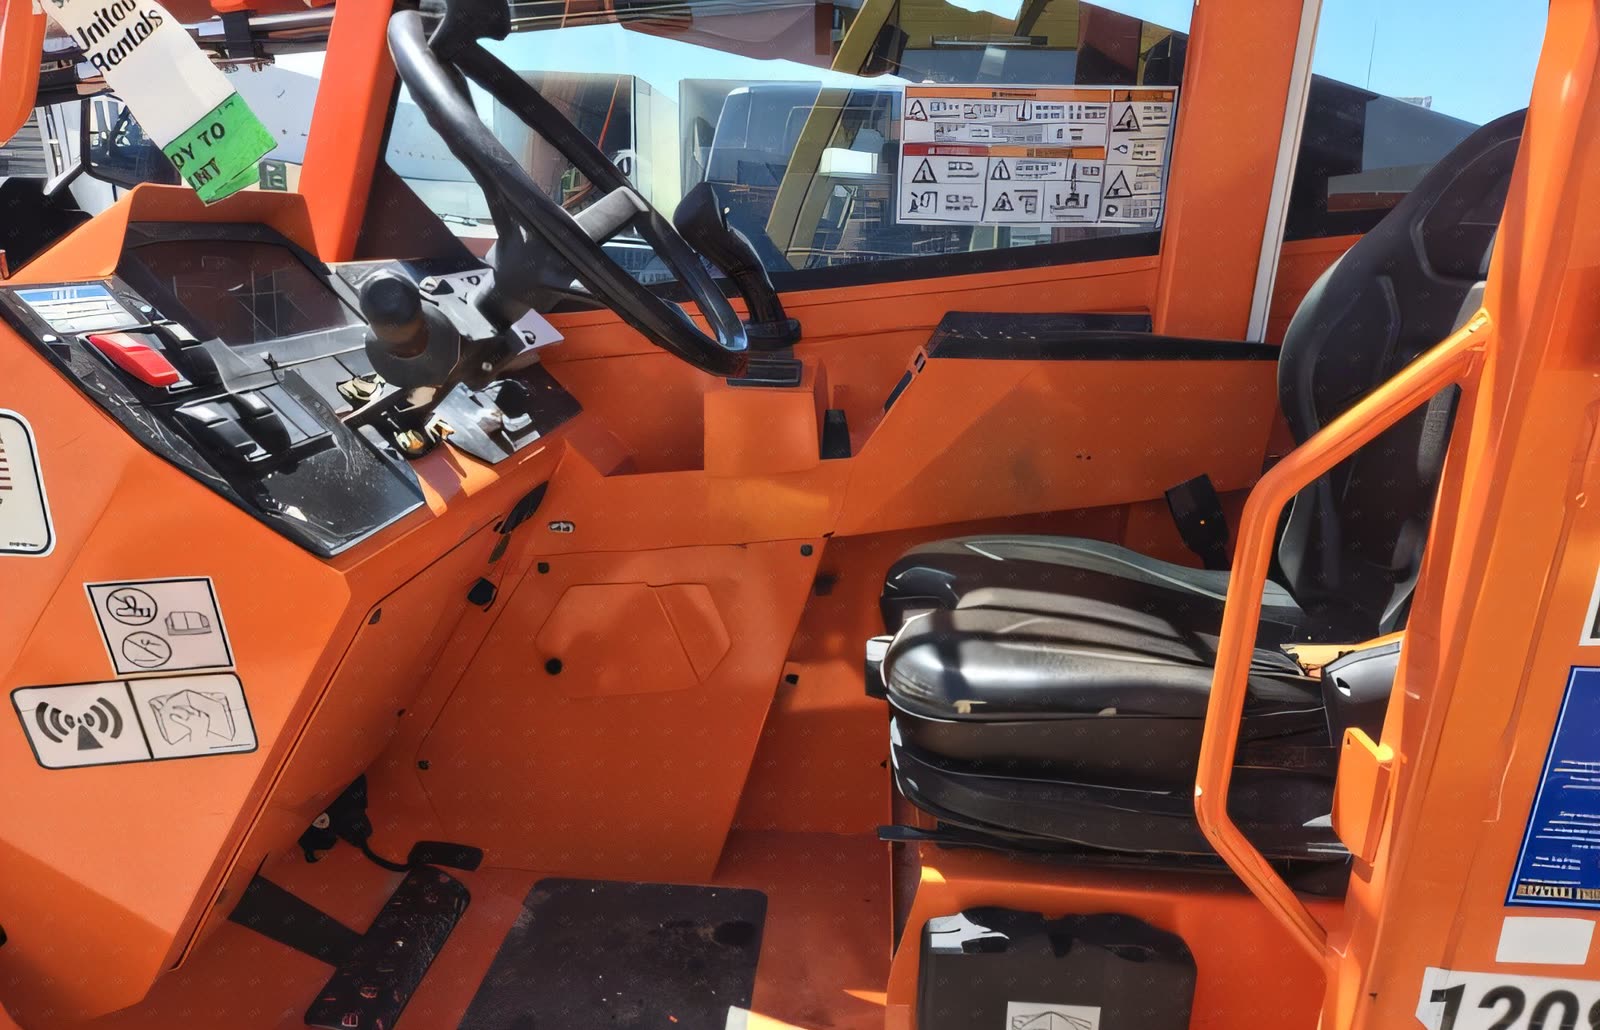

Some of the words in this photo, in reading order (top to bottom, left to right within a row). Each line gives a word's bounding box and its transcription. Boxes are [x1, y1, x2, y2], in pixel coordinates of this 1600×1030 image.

[90, 9, 164, 72] Rentals
[197, 122, 226, 147] TO
[1430, 983, 1600, 1030] 120
